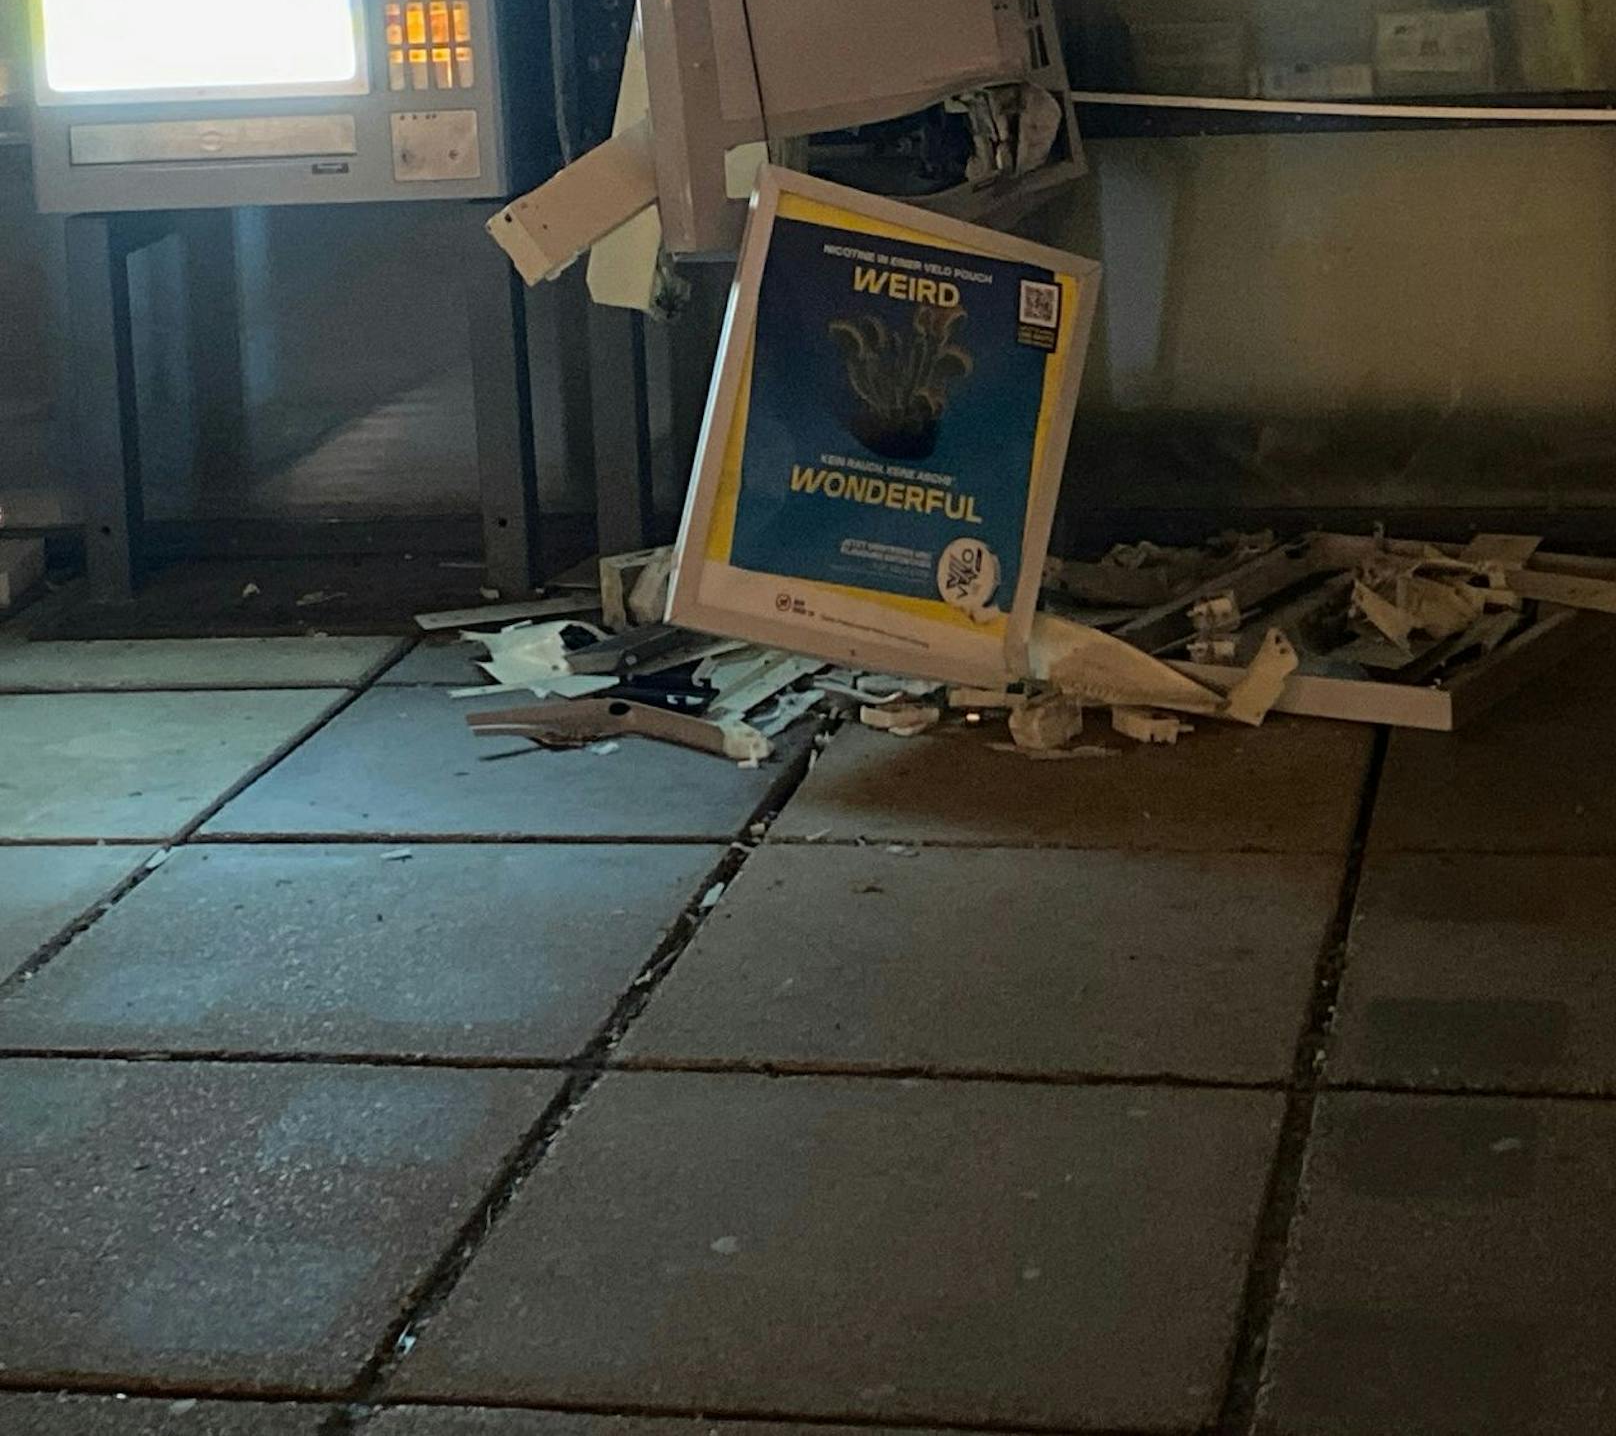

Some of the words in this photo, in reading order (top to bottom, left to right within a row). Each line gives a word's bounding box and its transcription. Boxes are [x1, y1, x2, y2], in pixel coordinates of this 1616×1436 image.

[823, 244, 875, 262] NICOTINE
[924, 263, 951, 278] VELO
[953, 268, 993, 285] POUCH
[853, 266, 961, 308] WEIRD
[790, 465, 983, 524] WONDERFUL
